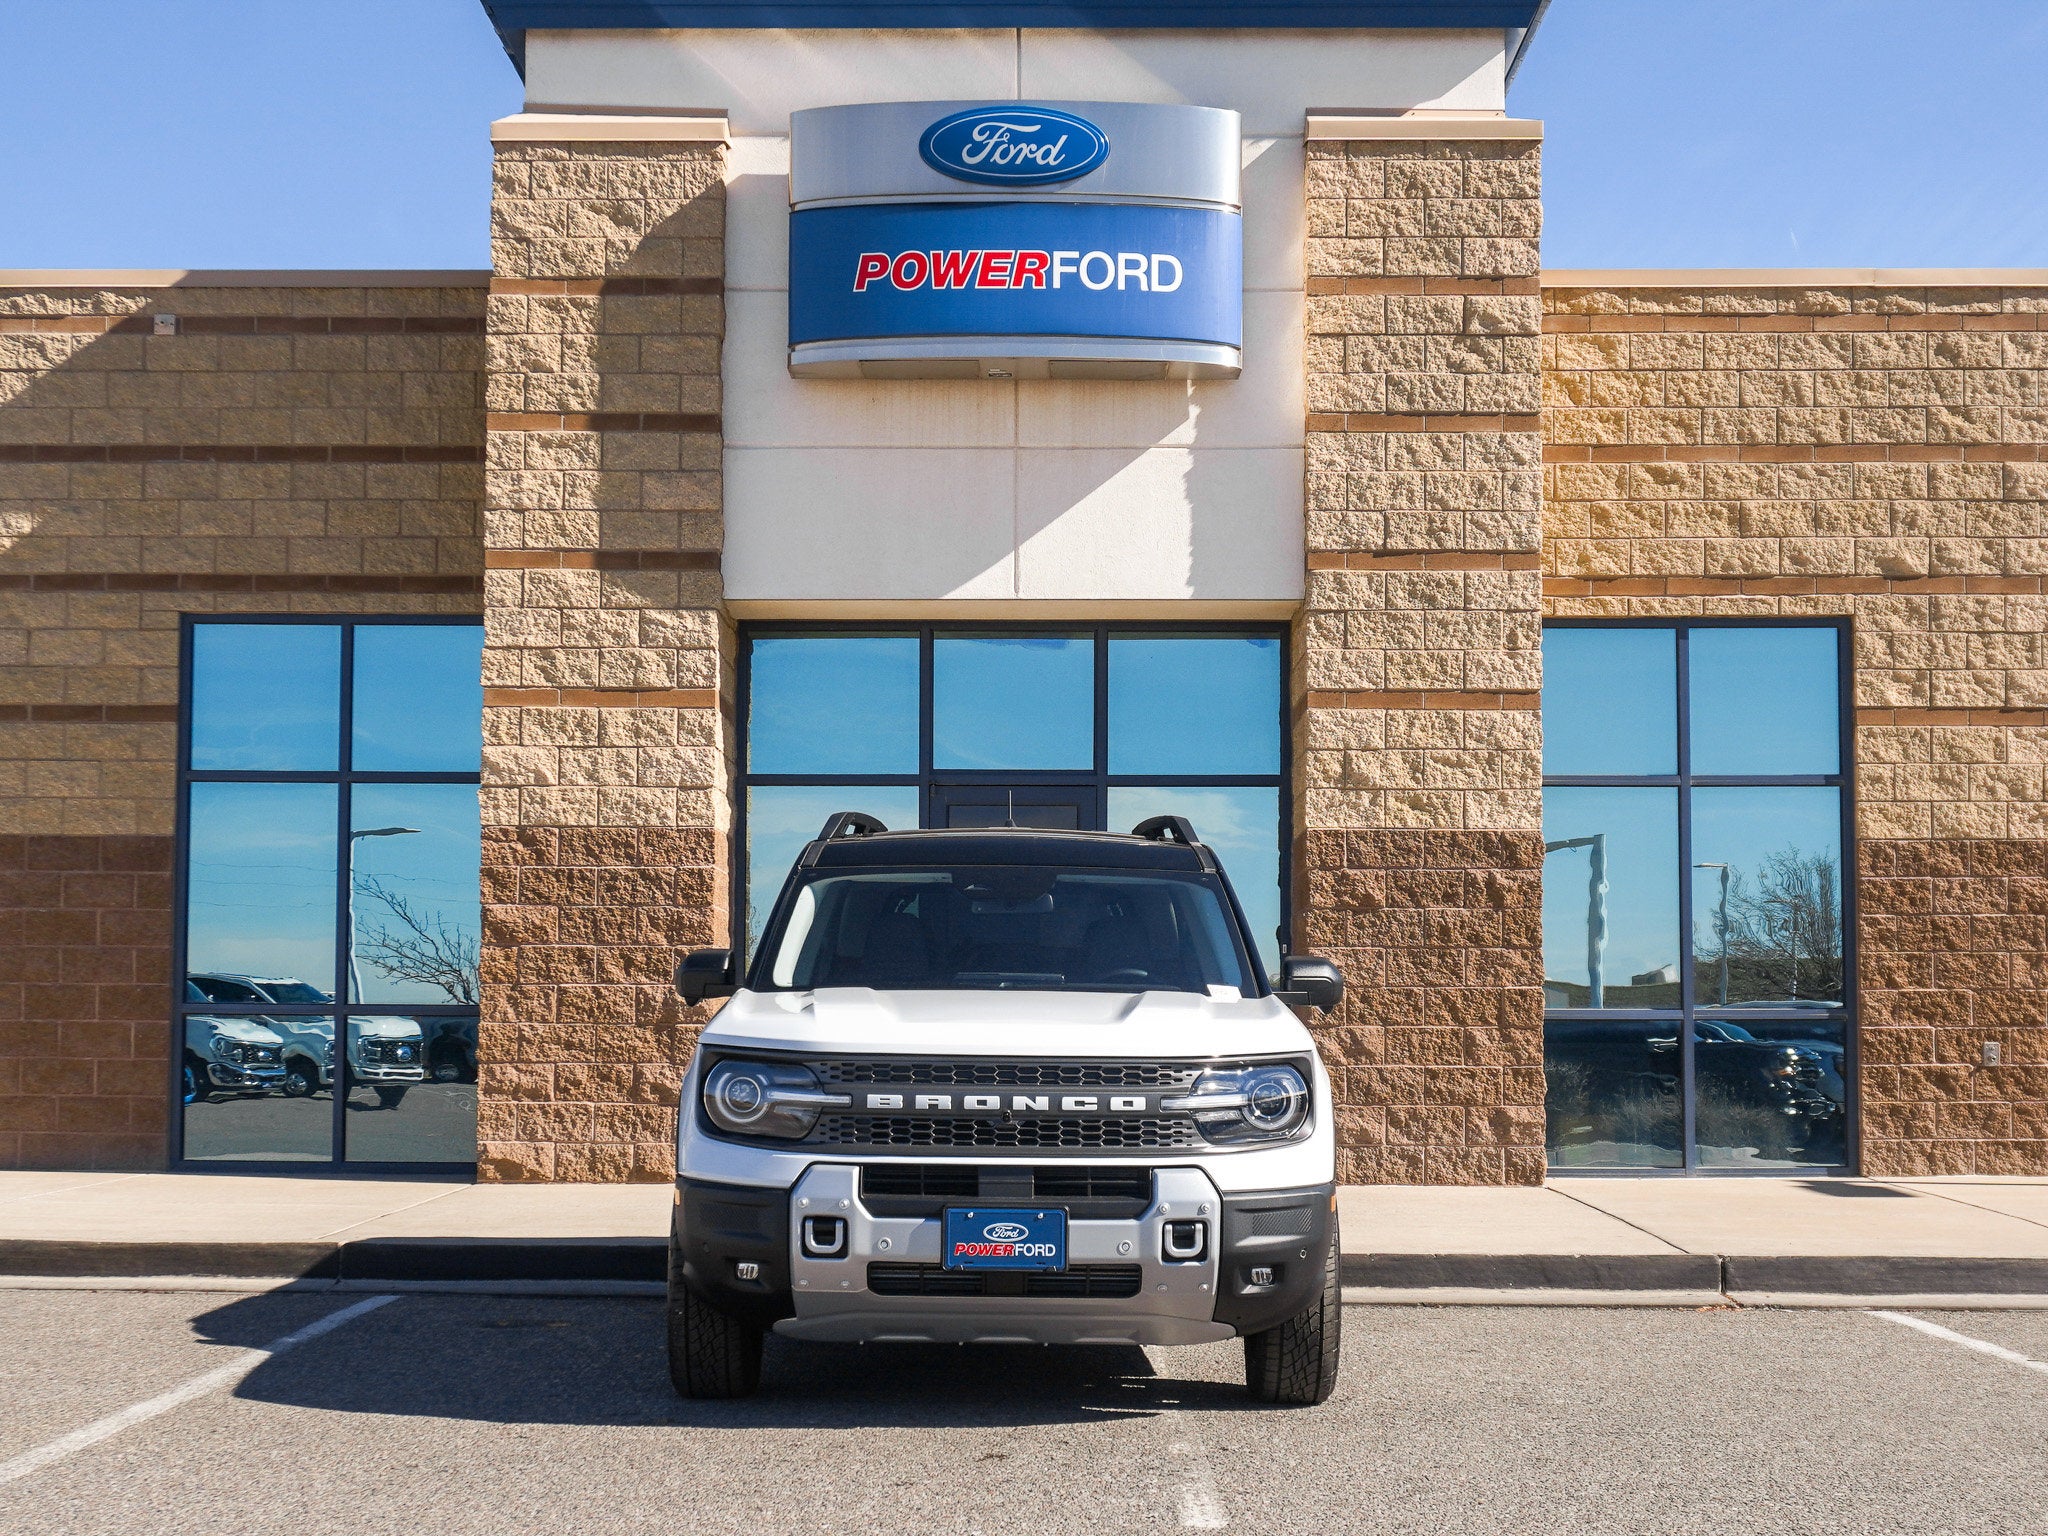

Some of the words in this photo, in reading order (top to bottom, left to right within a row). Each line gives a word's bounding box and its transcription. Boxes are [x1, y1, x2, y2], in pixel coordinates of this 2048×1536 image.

[962, 121, 1068, 167] Ford
[853, 249, 1183, 293] POWERFORD
[866, 1094, 1147, 1112] BRONCO
[991, 1226, 1020, 1239] Ford
[953, 1242, 1057, 1258] POWERFORD
